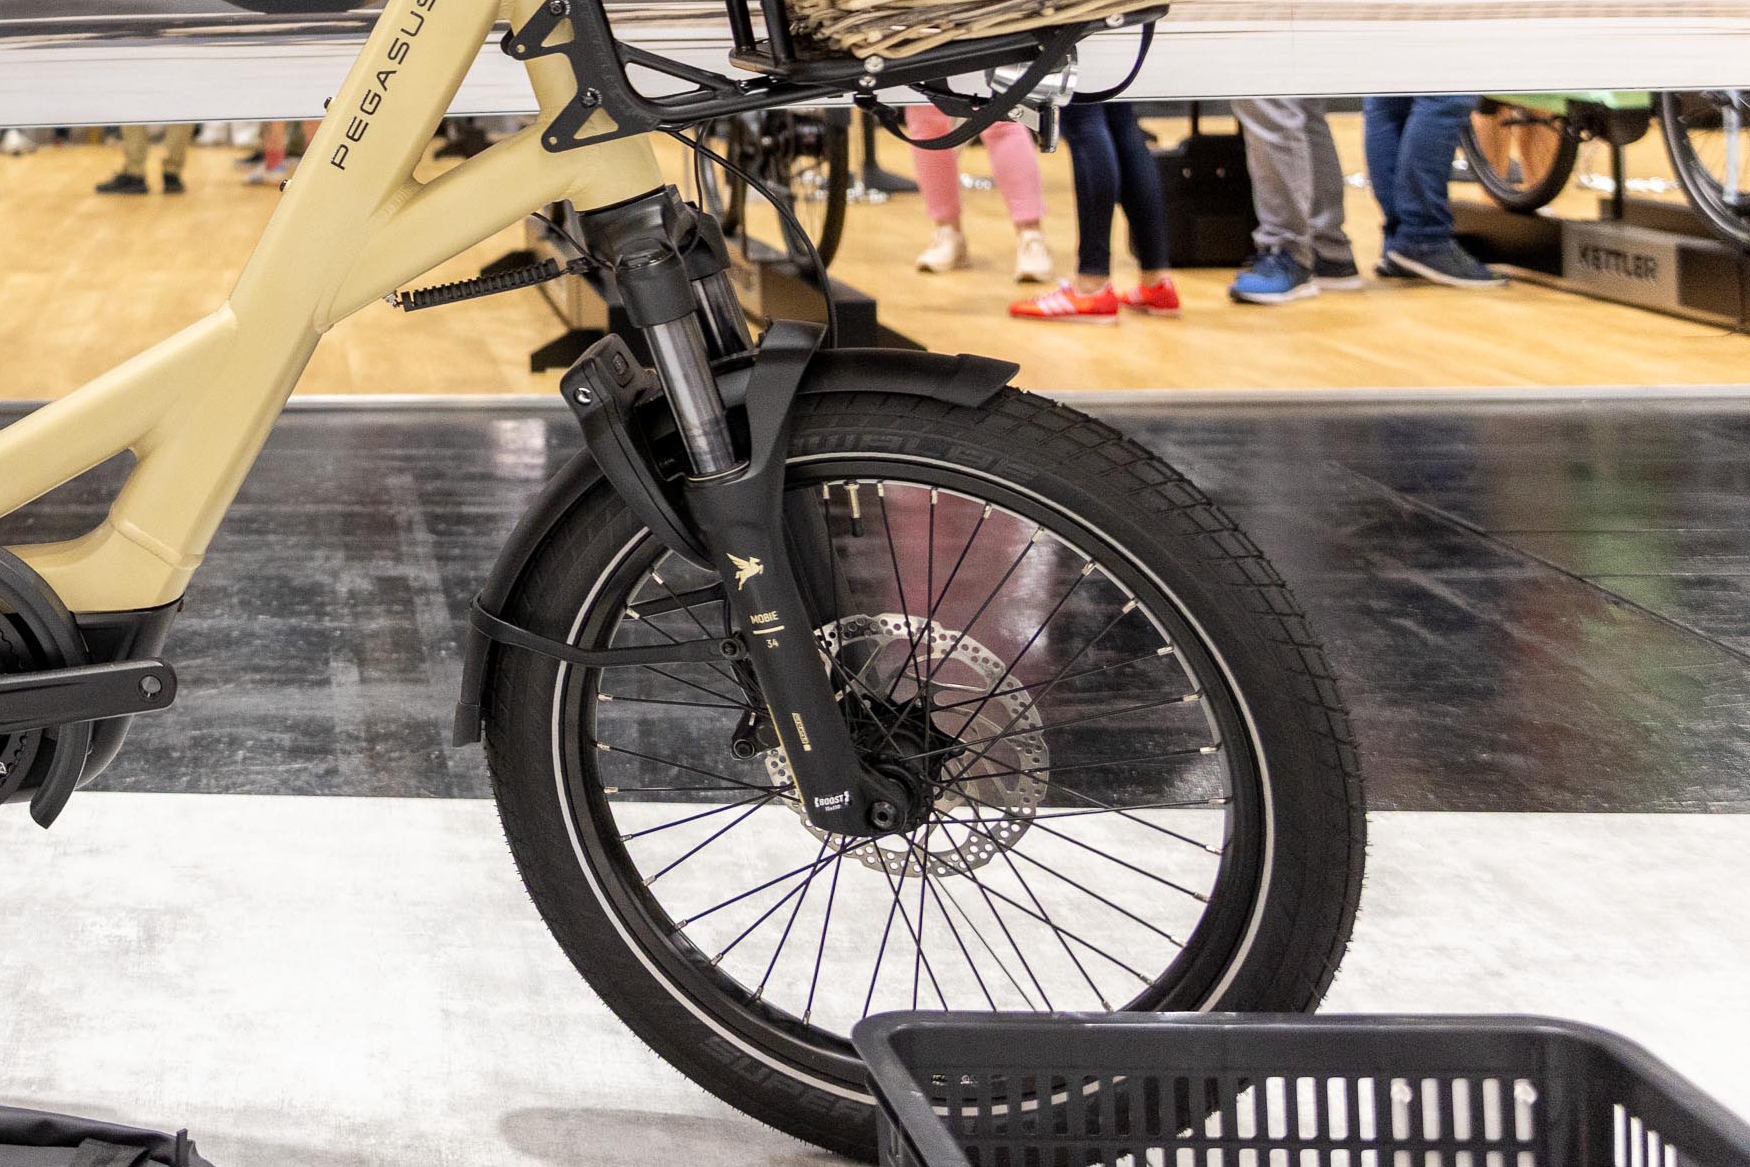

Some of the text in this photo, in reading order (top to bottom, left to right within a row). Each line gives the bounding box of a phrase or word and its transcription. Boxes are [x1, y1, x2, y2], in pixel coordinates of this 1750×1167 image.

[1578, 242, 1658, 281] KETTLER
[750, 611, 779, 624] MOBIE
[766, 638, 779, 648] 34
